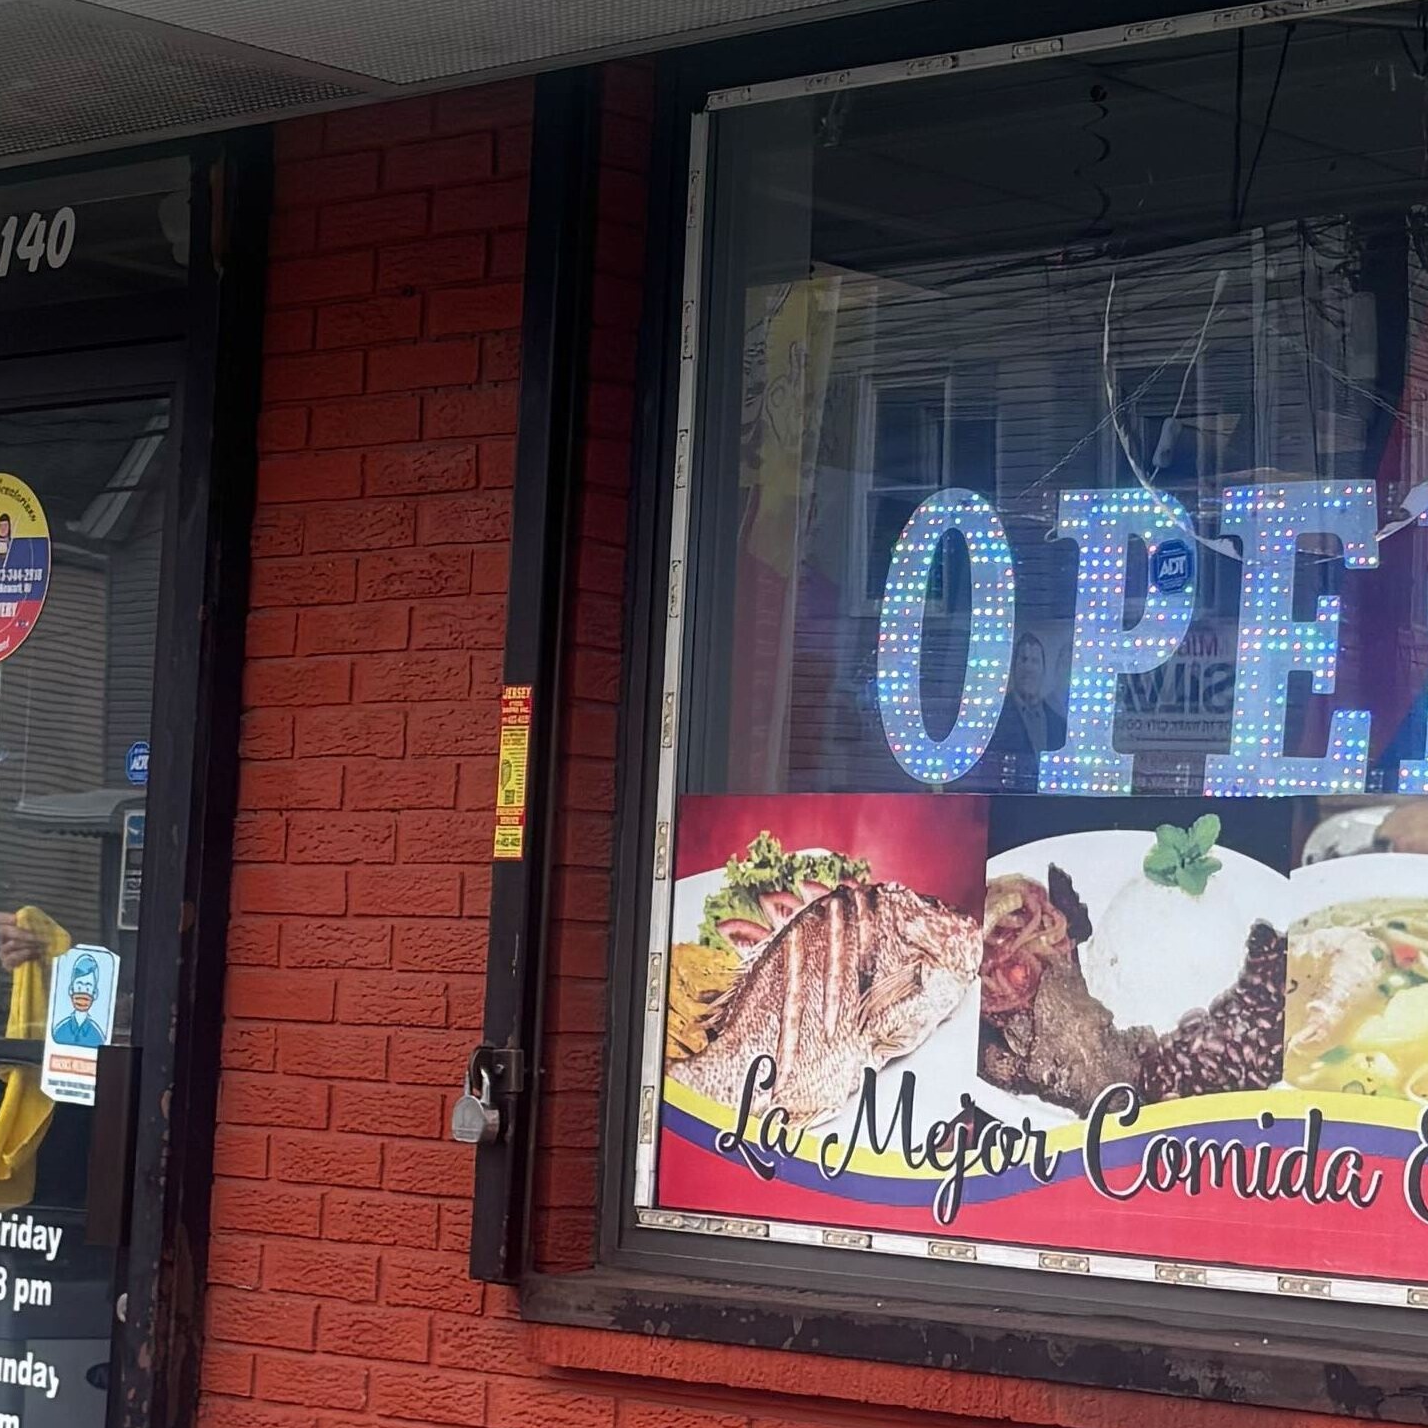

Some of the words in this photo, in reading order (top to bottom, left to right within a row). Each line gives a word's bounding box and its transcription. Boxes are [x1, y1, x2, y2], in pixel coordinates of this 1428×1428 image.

[1158, 556, 1187, 578] ADT
[715, 1054, 806, 1181] La
[820, 1066, 1068, 1227] Mejor
[1083, 1083, 1383, 1209] Comida
[13, 1278, 53, 1312] pm
